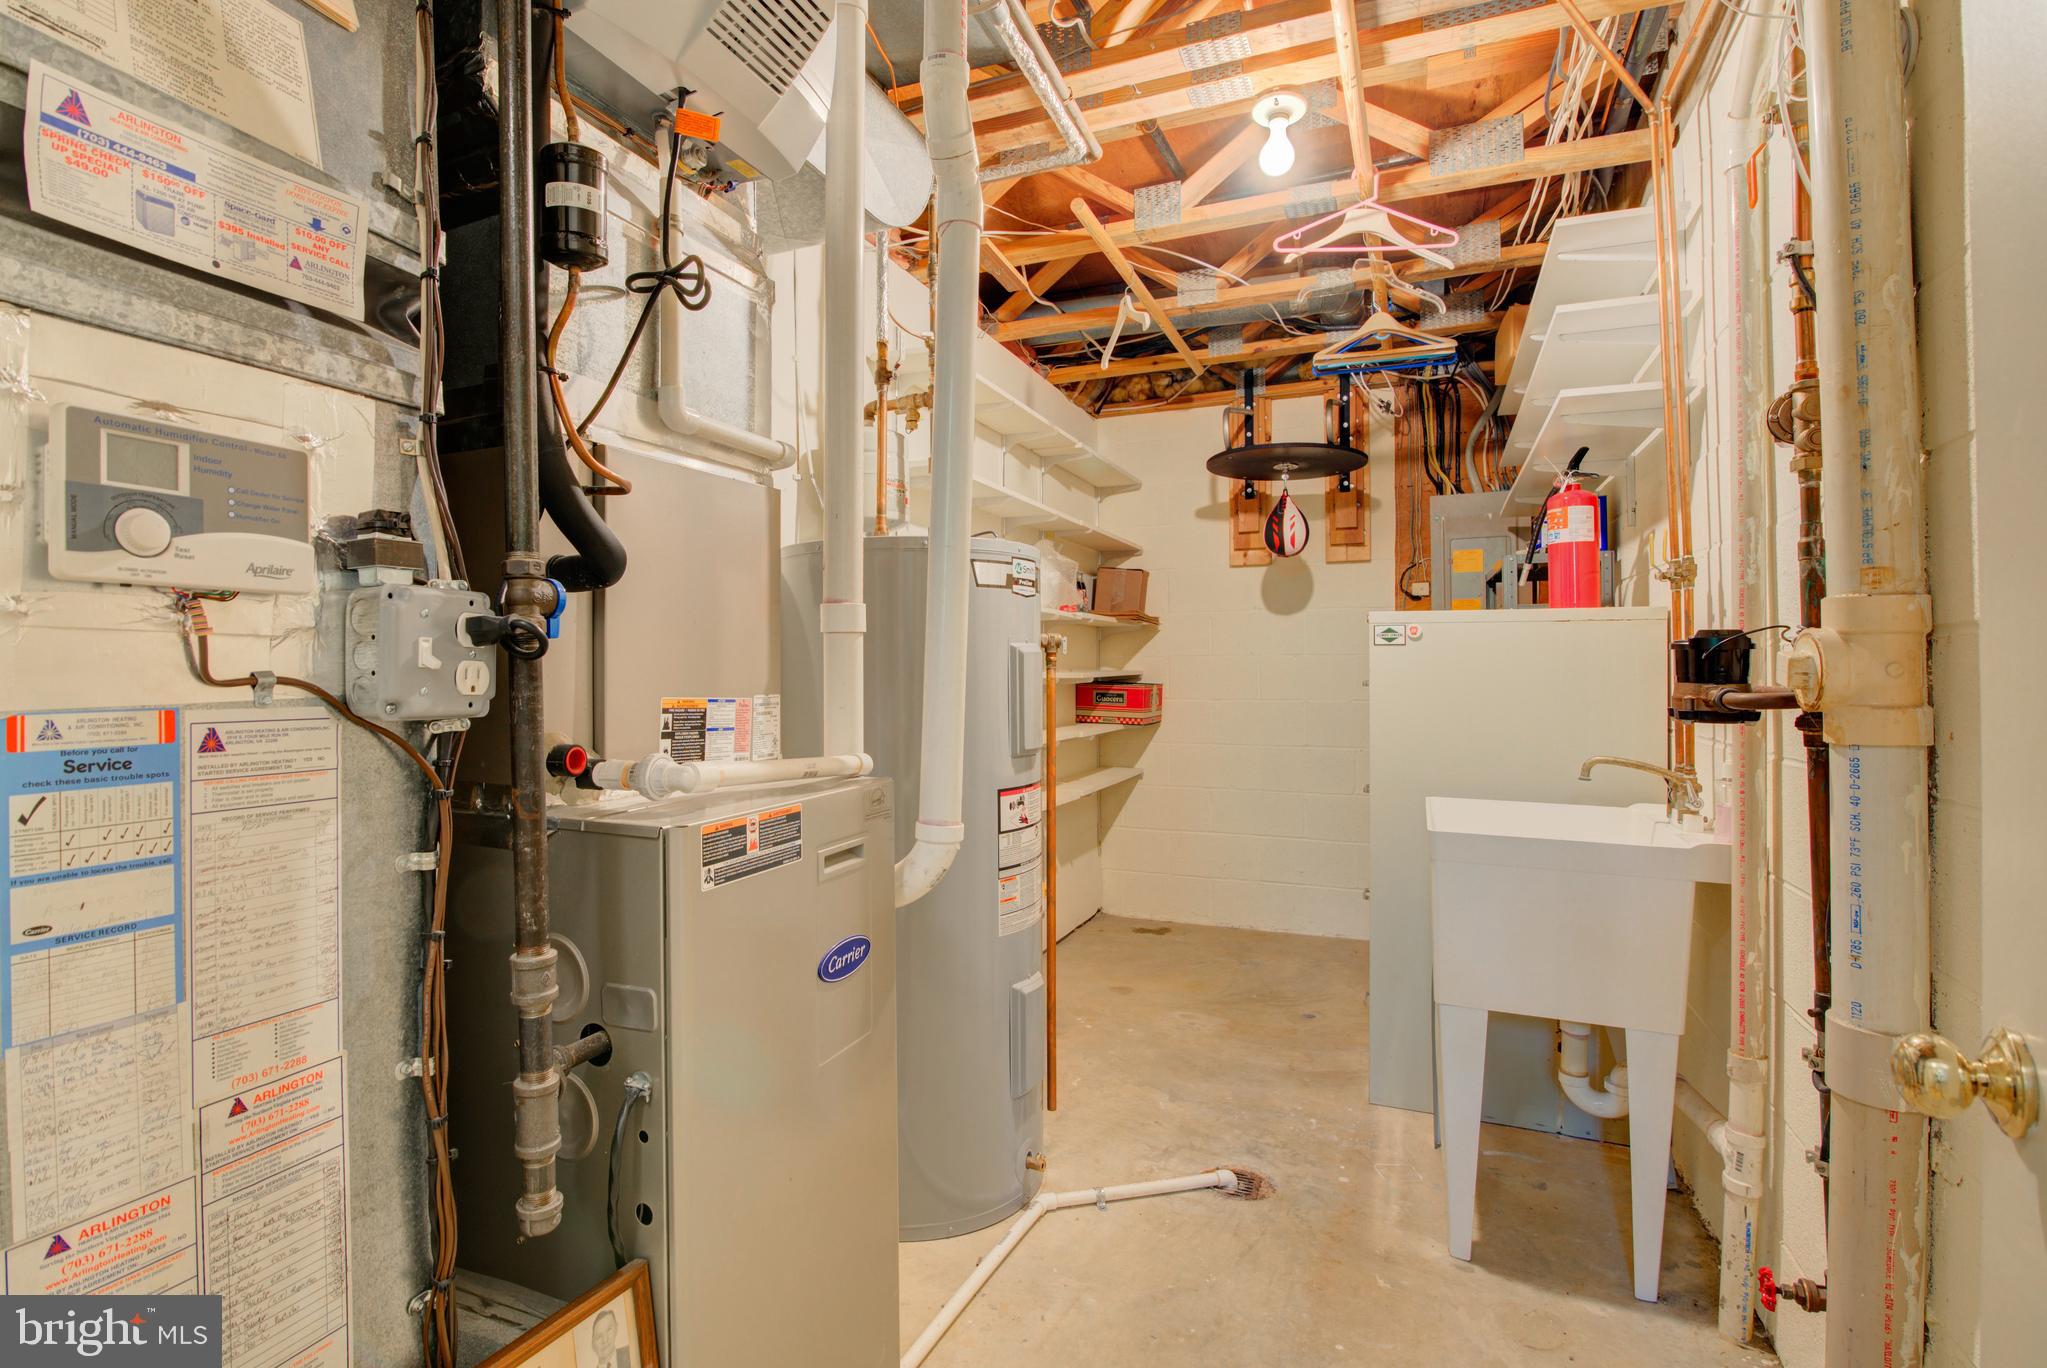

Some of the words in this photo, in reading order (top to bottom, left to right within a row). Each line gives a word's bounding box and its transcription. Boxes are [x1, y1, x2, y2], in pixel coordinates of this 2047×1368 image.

[77, 127, 109, 148] (703)
[117, 110, 181, 144] ARLINGTON
[41, 127, 88, 153] SPRING
[90, 145, 131, 169] CHECK
[51, 142, 69, 155] UP
[72, 150, 121, 175] SPECIAL
[64, 155, 109, 178] $49.00
[183, 184, 206, 199] OFF
[218, 219, 243, 235] $395
[246, 231, 285, 250] Installed
[295, 227, 326, 244] $10.00
[329, 239, 346, 251] OFF
[291, 242, 327, 261] SERVICE
[329, 256, 350, 269] CALL
[312, 242, 329, 254] ANY
[305, 258, 349, 281] ARLINGTON
[94, 415, 151, 434] Automatic
[155, 427, 210, 445] Humidifier
[211, 438, 248, 453] Control
[193, 454, 222, 465] Indoor
[193, 465, 233, 479] Humidity
[246, 562, 294, 578] Aprilaire
[60, 749, 89, 757] Before
[91, 749, 108, 757] you
[63, 758, 133, 774] Service
[1849, 757, 1861, 790] D-2665
[22, 779, 52, 789] check
[55, 777, 81, 786] these
[84, 775, 109, 784] basic
[111, 772, 144, 781] trouble
[145, 771, 170, 780] spots
[1850, 795, 1861, 807] 40
[1850, 812, 1861, 832] SCH.
[1850, 837, 1862, 857] 73°F
[52, 871, 78, 881] unable
[91, 866, 113, 875] locate
[1851, 863, 1862, 877] PSI
[1851, 882, 1862, 899] 260
[23, 926, 51, 936] Carrier
[54, 930, 96, 944] SERVICE
[98, 923, 137, 936] RECORD
[828, 944, 866, 974] Carrier
[231, 1072, 259, 1090] (703)
[261, 1056, 307, 1077] 671-2288
[252, 1070, 324, 1105] ARLINGTON
[240, 1114, 265, 1133] (703)
[268, 1097, 309, 1120] 671-2288
[79, 1194, 171, 1241] ARLINGTON
[60, 1251, 94, 1276] (703)
[98, 1226, 152, 1259] 671-2288
[45, 1232, 167, 1293] www.ArlingtonHeating.com
